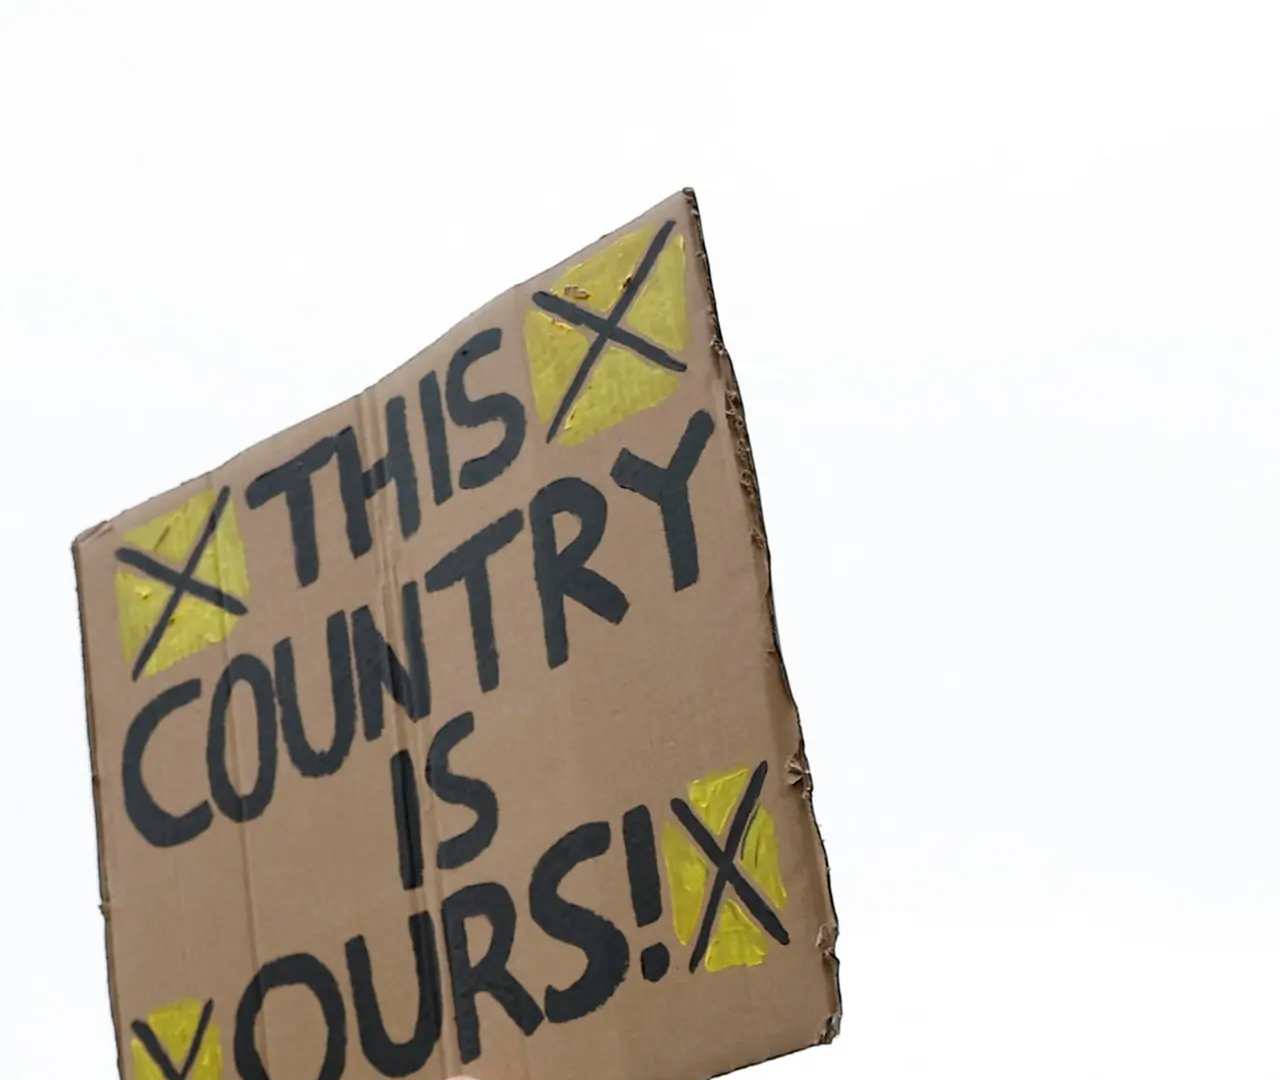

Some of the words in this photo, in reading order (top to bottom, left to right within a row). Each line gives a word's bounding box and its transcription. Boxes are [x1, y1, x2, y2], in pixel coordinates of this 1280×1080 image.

[245, 327, 527, 588] THIS
[121, 409, 715, 848] COUNTRY
[389, 711, 499, 891] IS
